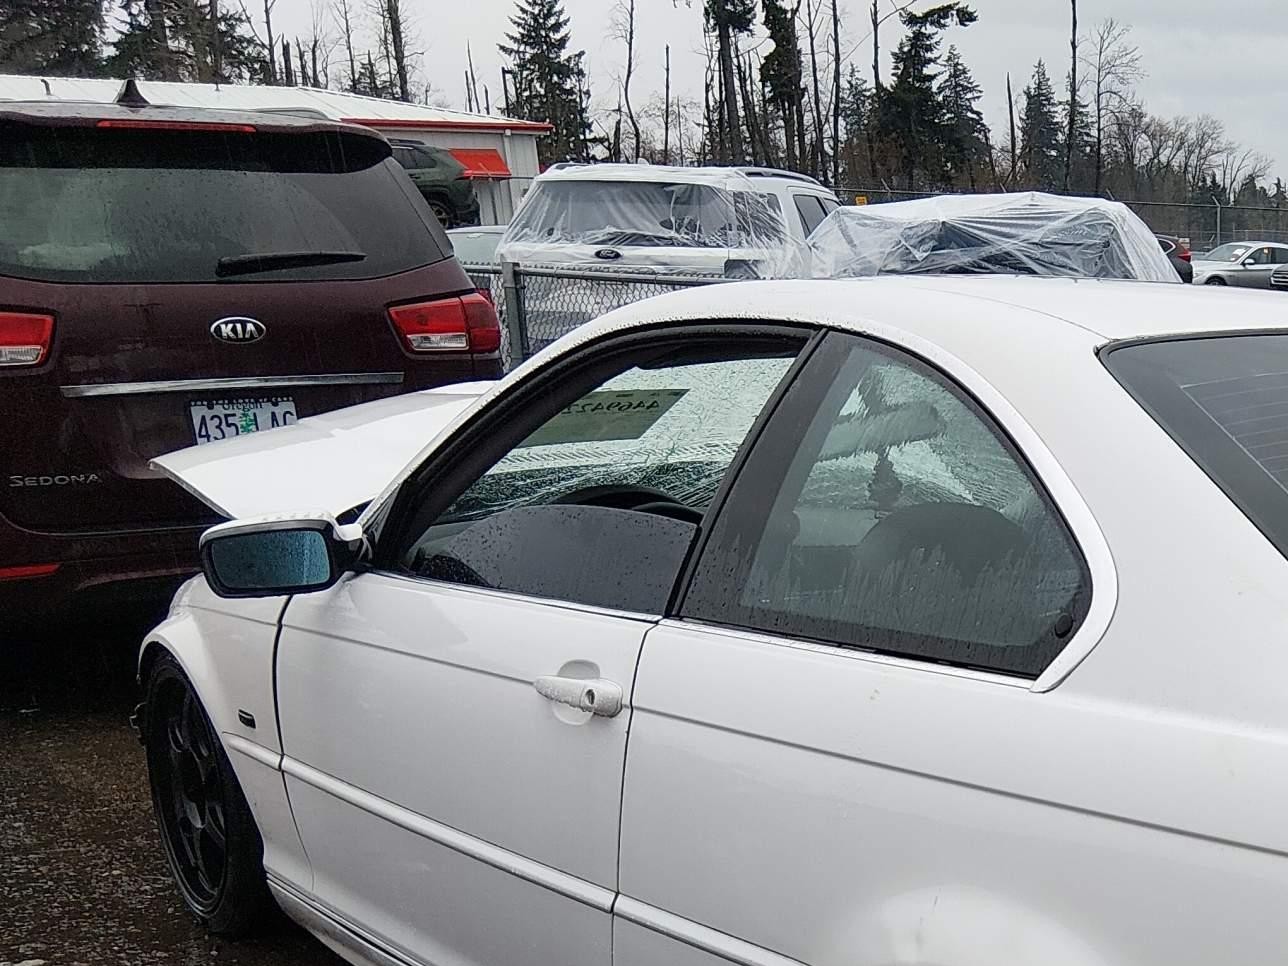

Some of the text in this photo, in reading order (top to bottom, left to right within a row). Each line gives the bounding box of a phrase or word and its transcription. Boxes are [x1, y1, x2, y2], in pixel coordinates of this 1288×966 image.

[220, 322, 259, 339] KIA
[198, 413, 239, 442] 435
[9, 474, 102, 487] SEDONA
